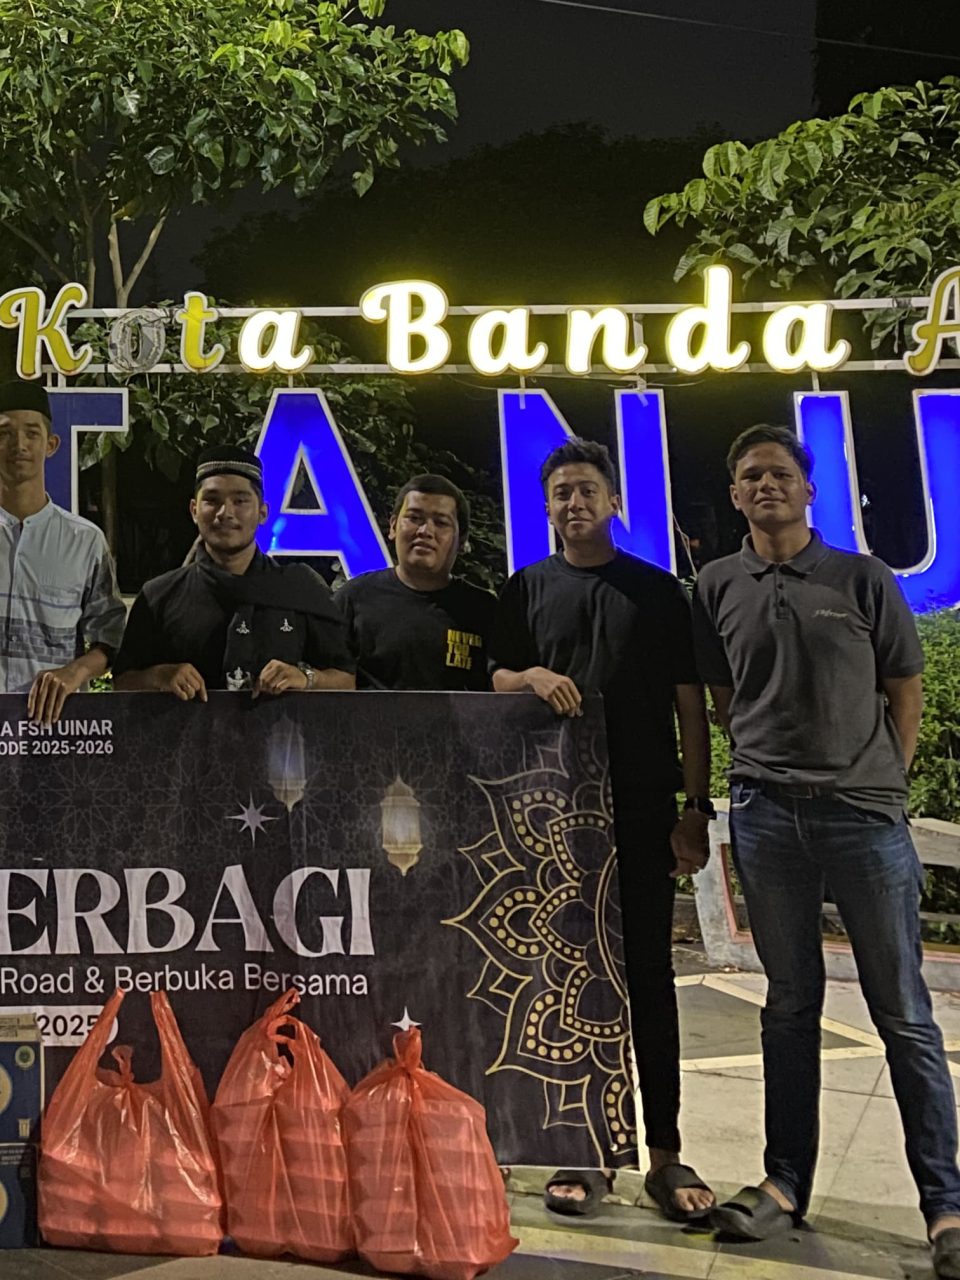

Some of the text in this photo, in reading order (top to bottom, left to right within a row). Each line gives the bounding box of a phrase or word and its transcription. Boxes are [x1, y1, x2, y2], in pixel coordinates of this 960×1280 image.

[360, 265, 851, 375] Banda
[18, 720, 53, 737] FSH
[57, 719, 113, 736] UINAR
[32, 739, 114, 755] 2025-2026
[0, 966, 74, 994] Road
[84, 966, 105, 993] &
[114, 963, 234, 993] Berbuka
[244, 963, 368, 995] Bersama
